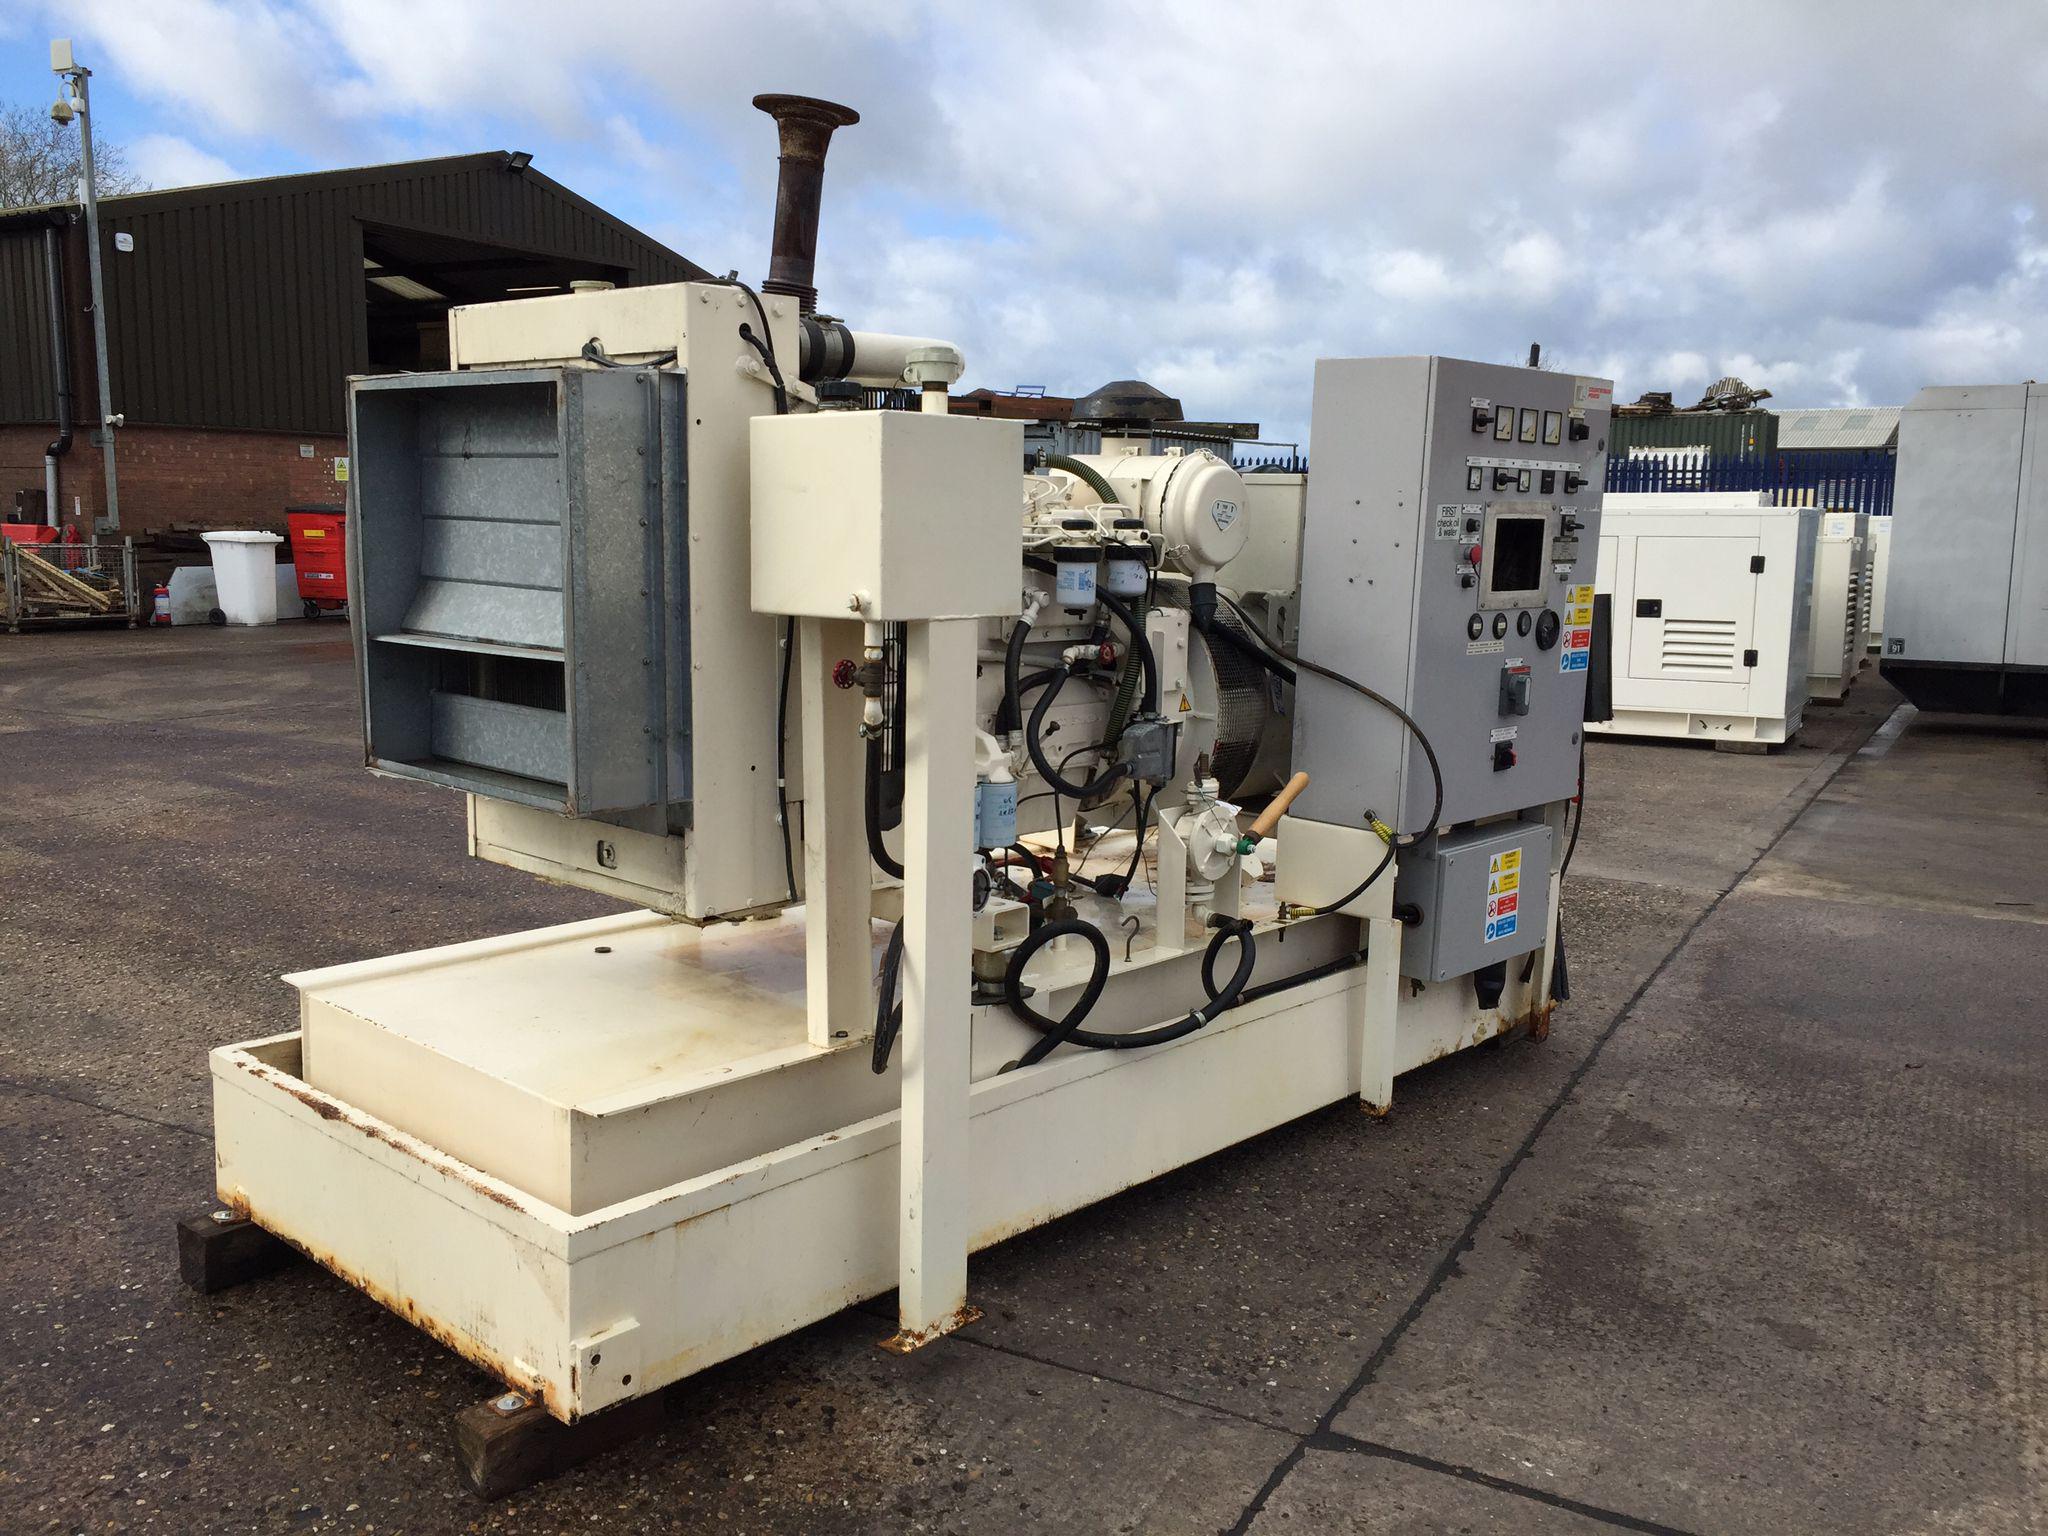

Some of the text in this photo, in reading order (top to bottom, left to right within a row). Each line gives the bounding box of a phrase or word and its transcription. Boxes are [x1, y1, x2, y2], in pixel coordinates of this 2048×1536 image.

[1442, 506, 1457, 516] FIRST
[1437, 518, 1453, 527] check
[1444, 528, 1458, 537] water
